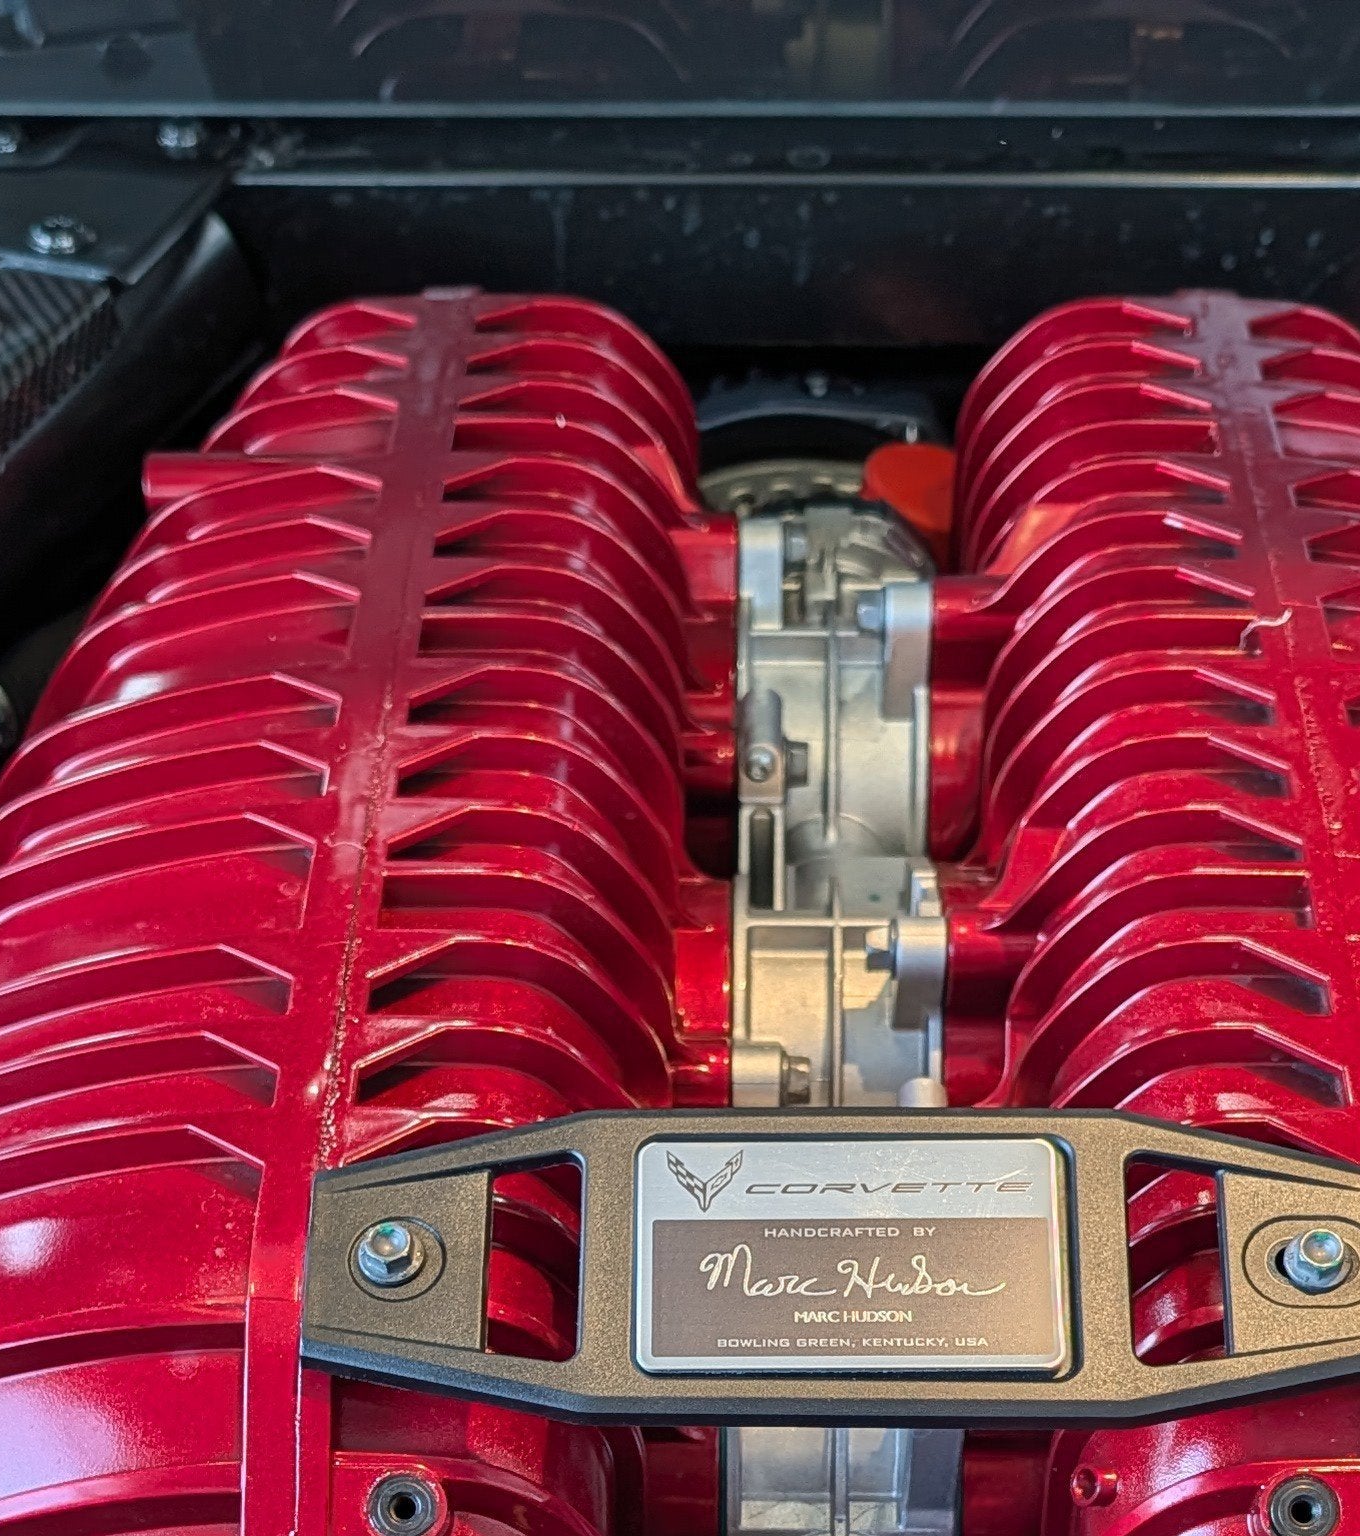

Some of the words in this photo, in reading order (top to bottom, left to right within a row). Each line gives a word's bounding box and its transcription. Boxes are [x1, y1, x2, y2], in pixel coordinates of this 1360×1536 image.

[745, 1181, 1033, 1196] CORVETTE
[763, 1226, 899, 1238] HANDCRAFTED
[912, 1226, 936, 1238] BY
[699, 1243, 838, 1298] Marc
[793, 1310, 840, 1324] MARC
[842, 1310, 914, 1324] HUDSON
[716, 1337, 791, 1348] BOWLING
[796, 1337, 856, 1350] GREEN,
[861, 1337, 949, 1350] KENTUCKY,
[954, 1337, 989, 1348] USA
